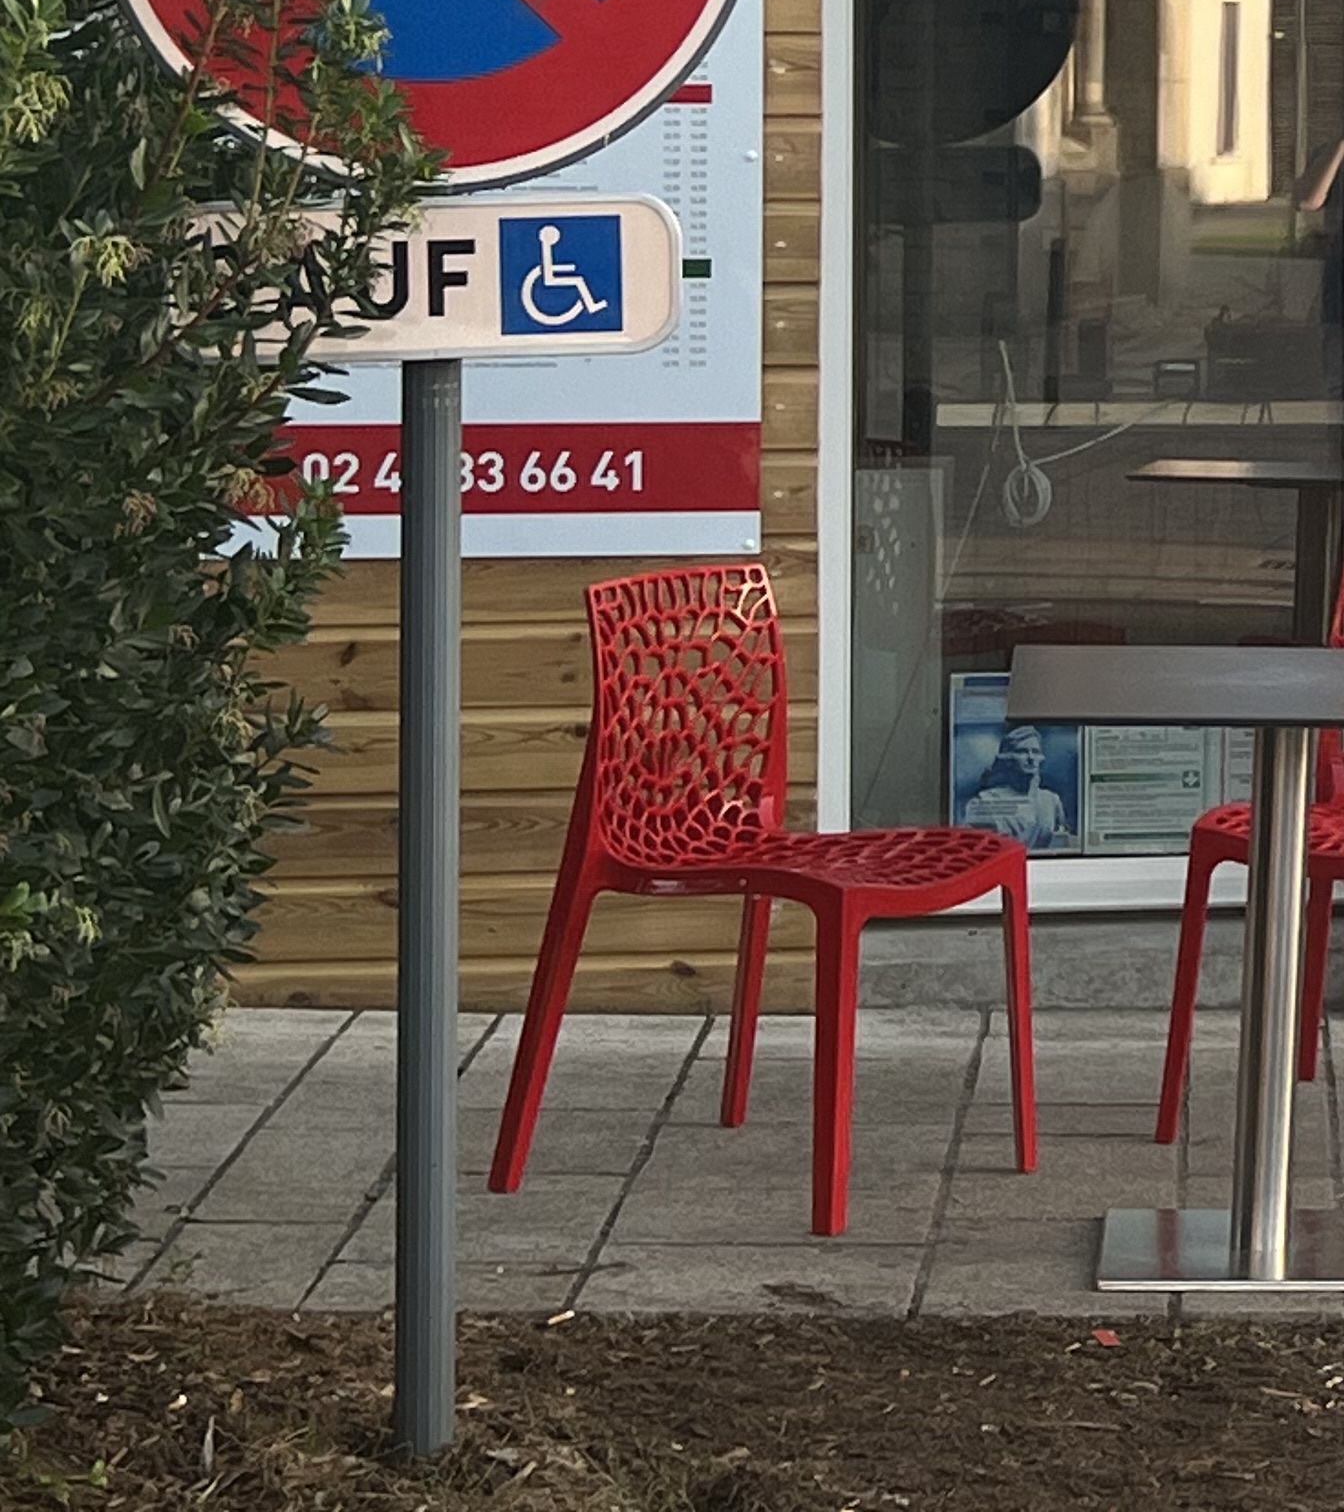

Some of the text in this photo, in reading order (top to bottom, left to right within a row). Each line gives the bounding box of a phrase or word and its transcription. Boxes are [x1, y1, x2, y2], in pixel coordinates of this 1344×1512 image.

[302, 452, 360, 493] 02
[520, 450, 577, 492] 66
[591, 450, 644, 492] 41
